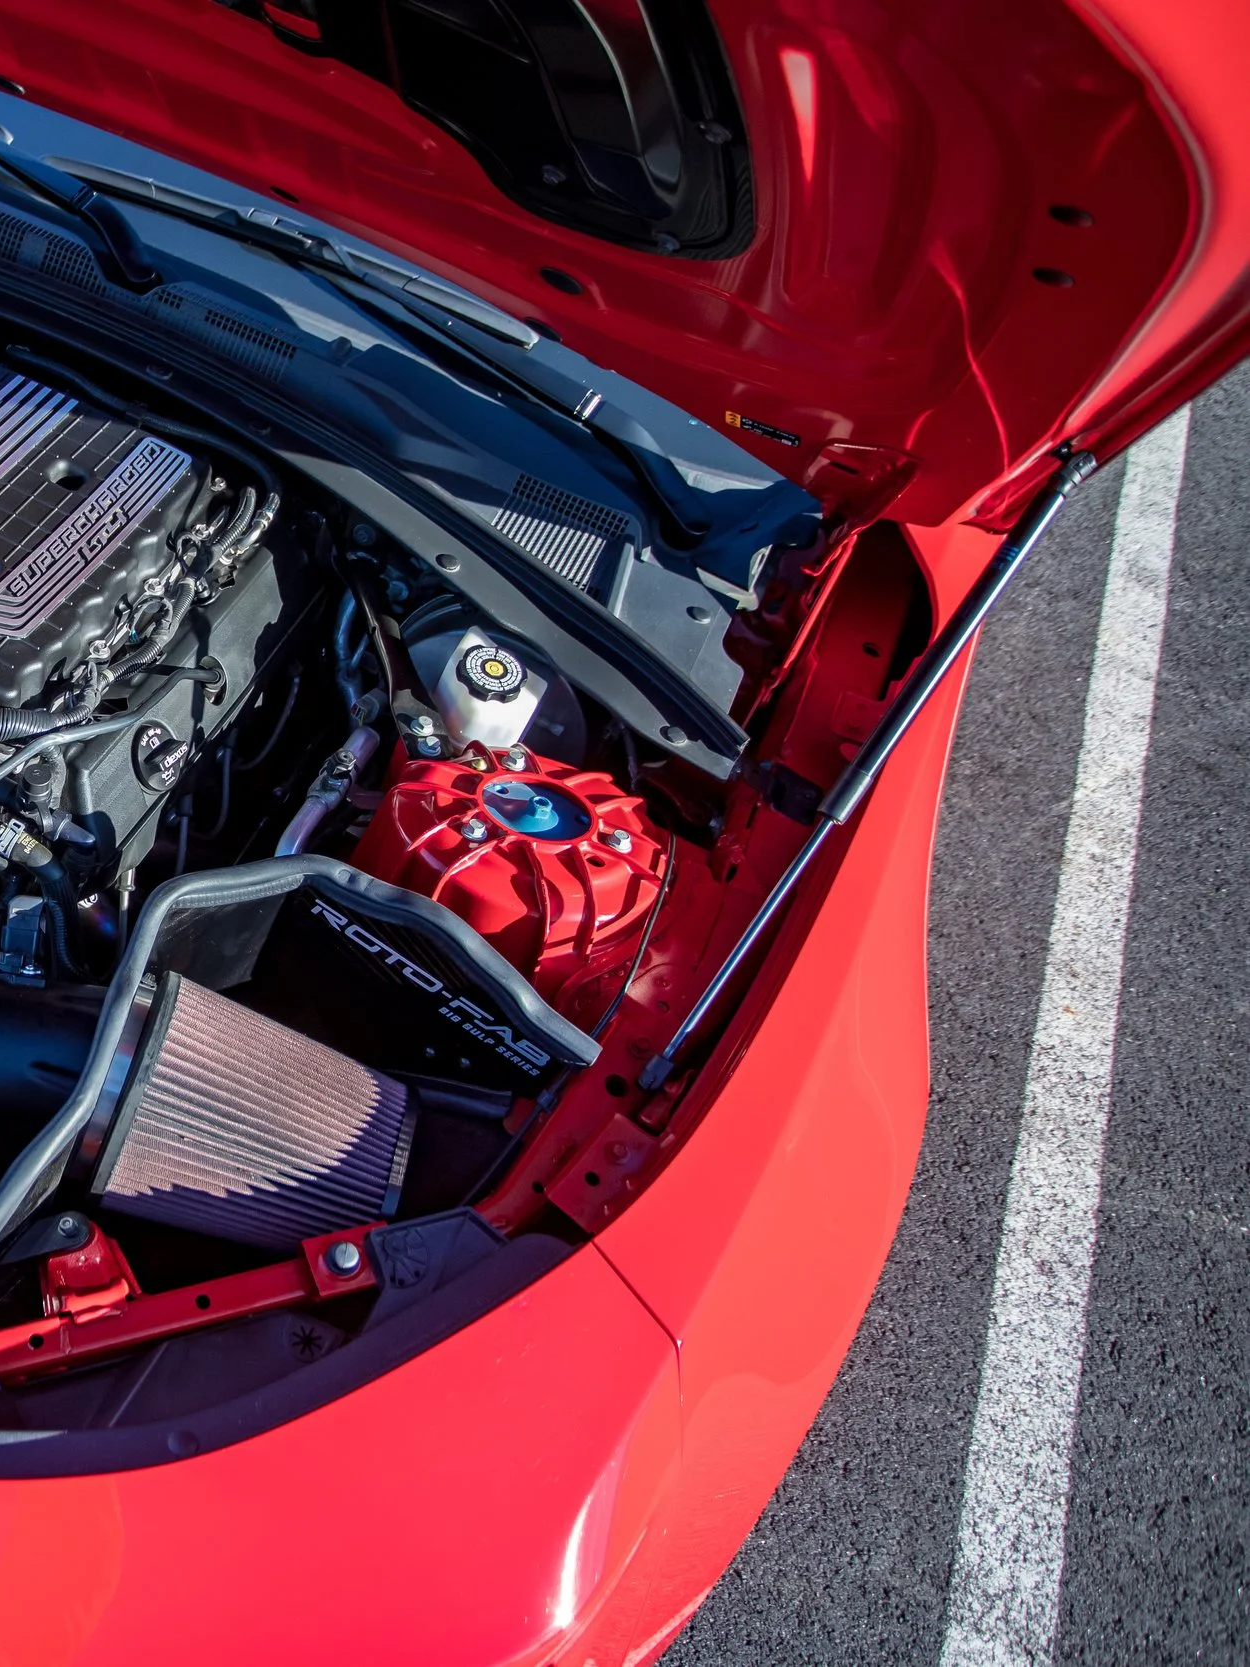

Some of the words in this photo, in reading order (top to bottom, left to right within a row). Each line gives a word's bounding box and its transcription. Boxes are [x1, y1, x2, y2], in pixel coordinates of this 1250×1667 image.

[8, 442, 161, 597] SUPERCHARGED
[164, 743, 188, 768] dexos
[310, 899, 551, 1067] ROTO-FAB
[438, 1006, 462, 1023] BIG
[462, 1023, 495, 1045] GULP
[495, 1046, 541, 1076] SERIES
